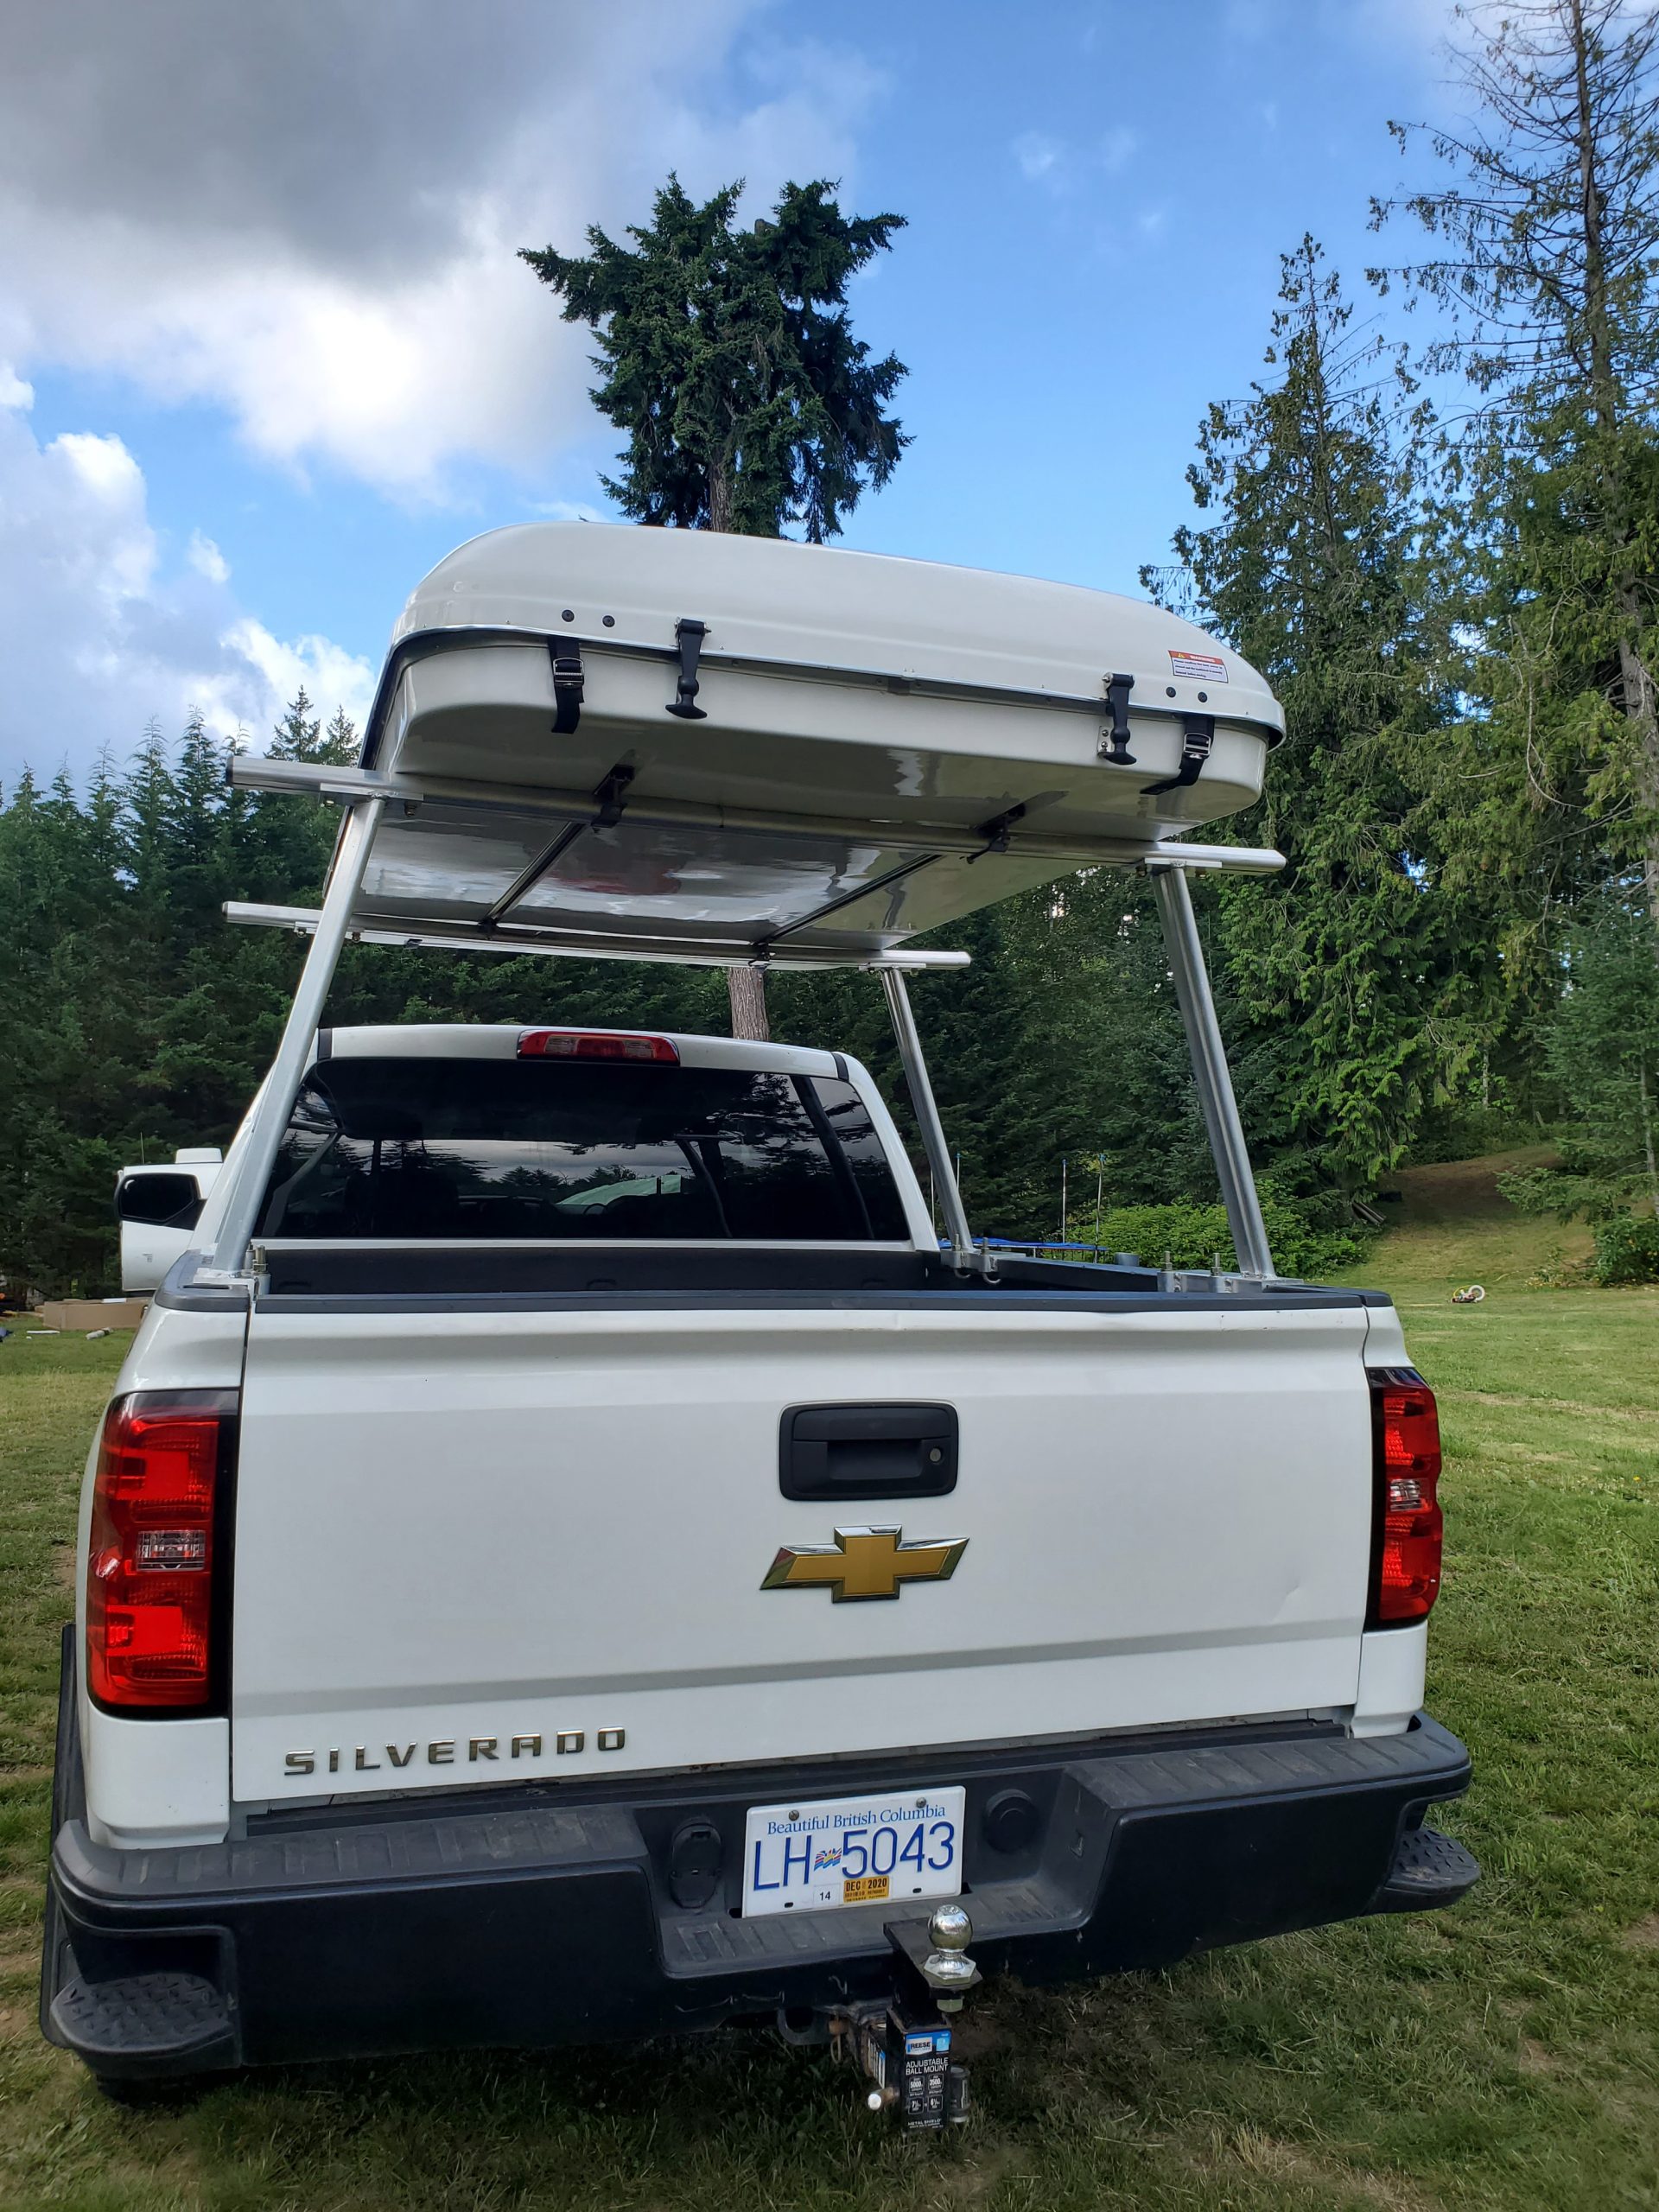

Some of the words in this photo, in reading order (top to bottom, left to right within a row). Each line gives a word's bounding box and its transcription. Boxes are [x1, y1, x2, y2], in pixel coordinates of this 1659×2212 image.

[284, 1726, 626, 1777] SILVERADO
[767, 1815, 830, 1834] Beautiful
[833, 1809, 876, 1828] British
[880, 1805, 945, 1823] Columbia
[753, 1834, 812, 1891] LH
[842, 1821, 955, 1878] 5043
[846, 1880, 861, 1891] DEC
[868, 1878, 887, 1889] 2020
[819, 1891, 831, 1901] 14
[906, 2057, 949, 2069] ADJUSTABLE
[906, 2067, 922, 2075] BALL
[924, 2064, 949, 2074] MOUNT
